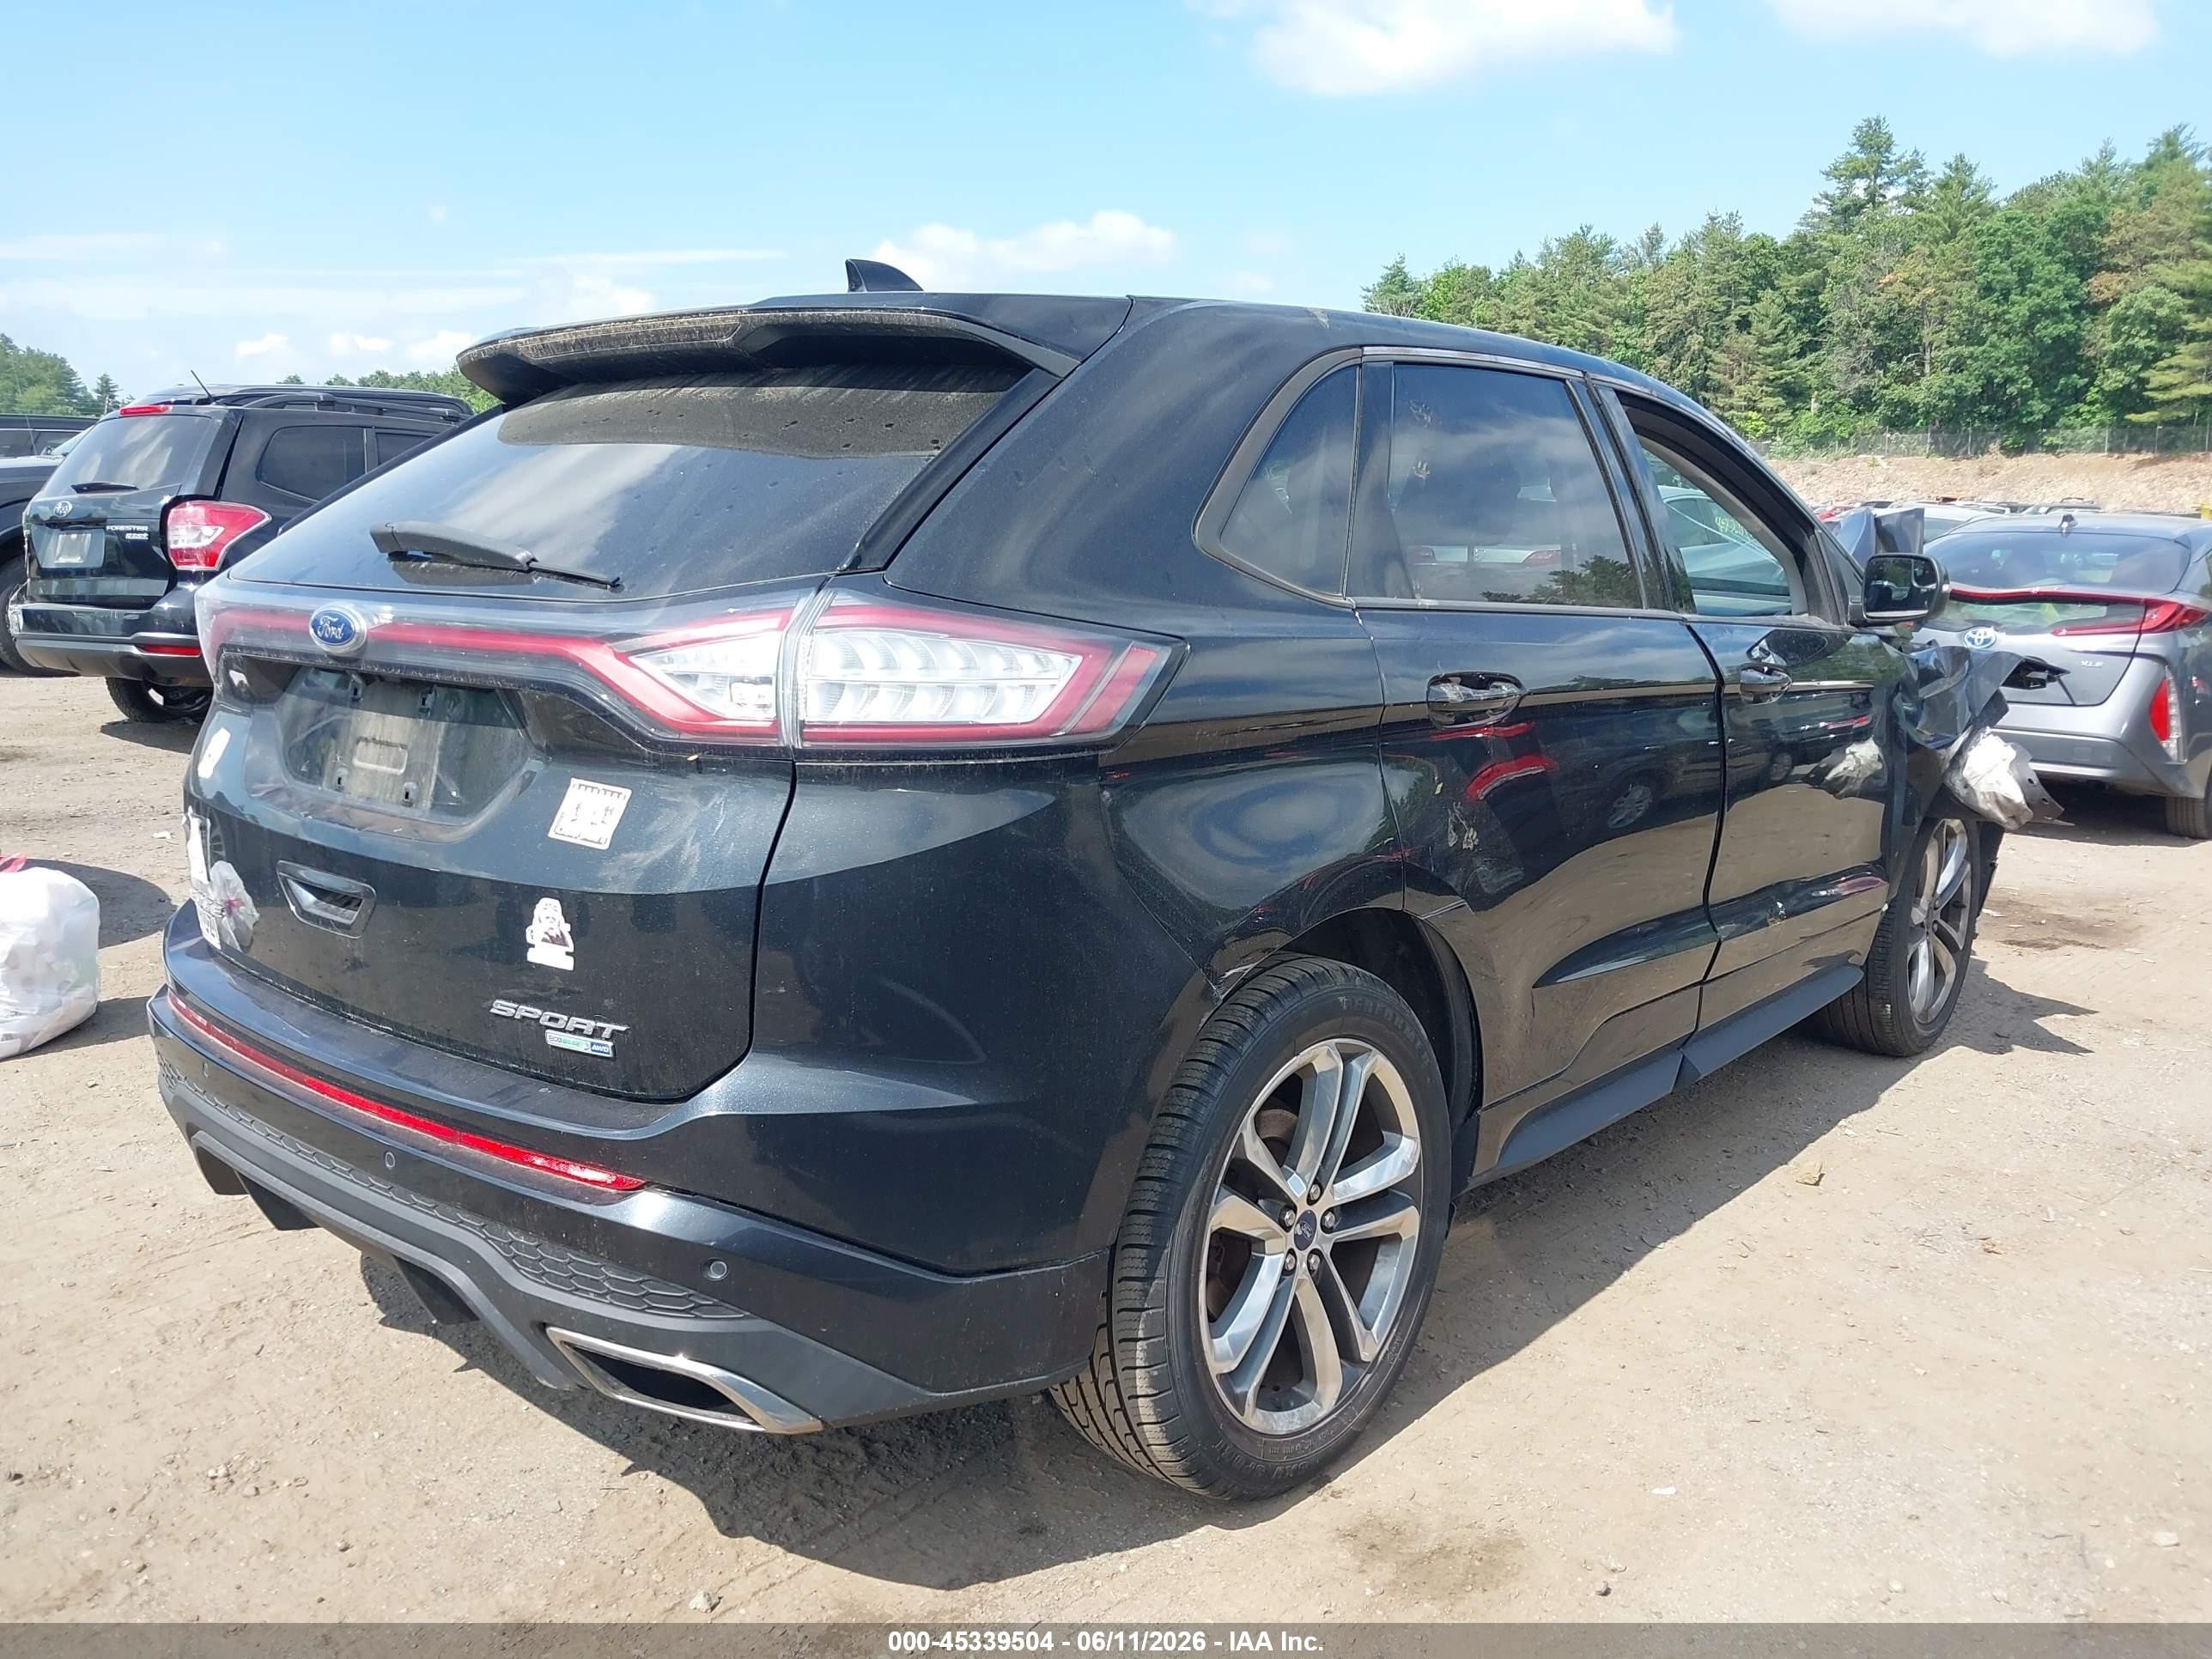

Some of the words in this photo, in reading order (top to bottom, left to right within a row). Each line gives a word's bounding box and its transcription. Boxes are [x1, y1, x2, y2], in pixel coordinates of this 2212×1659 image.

[317, 615, 345, 640] Ford
[489, 999, 630, 1039] SPORT
[591, 1044, 609, 1053] AWD
